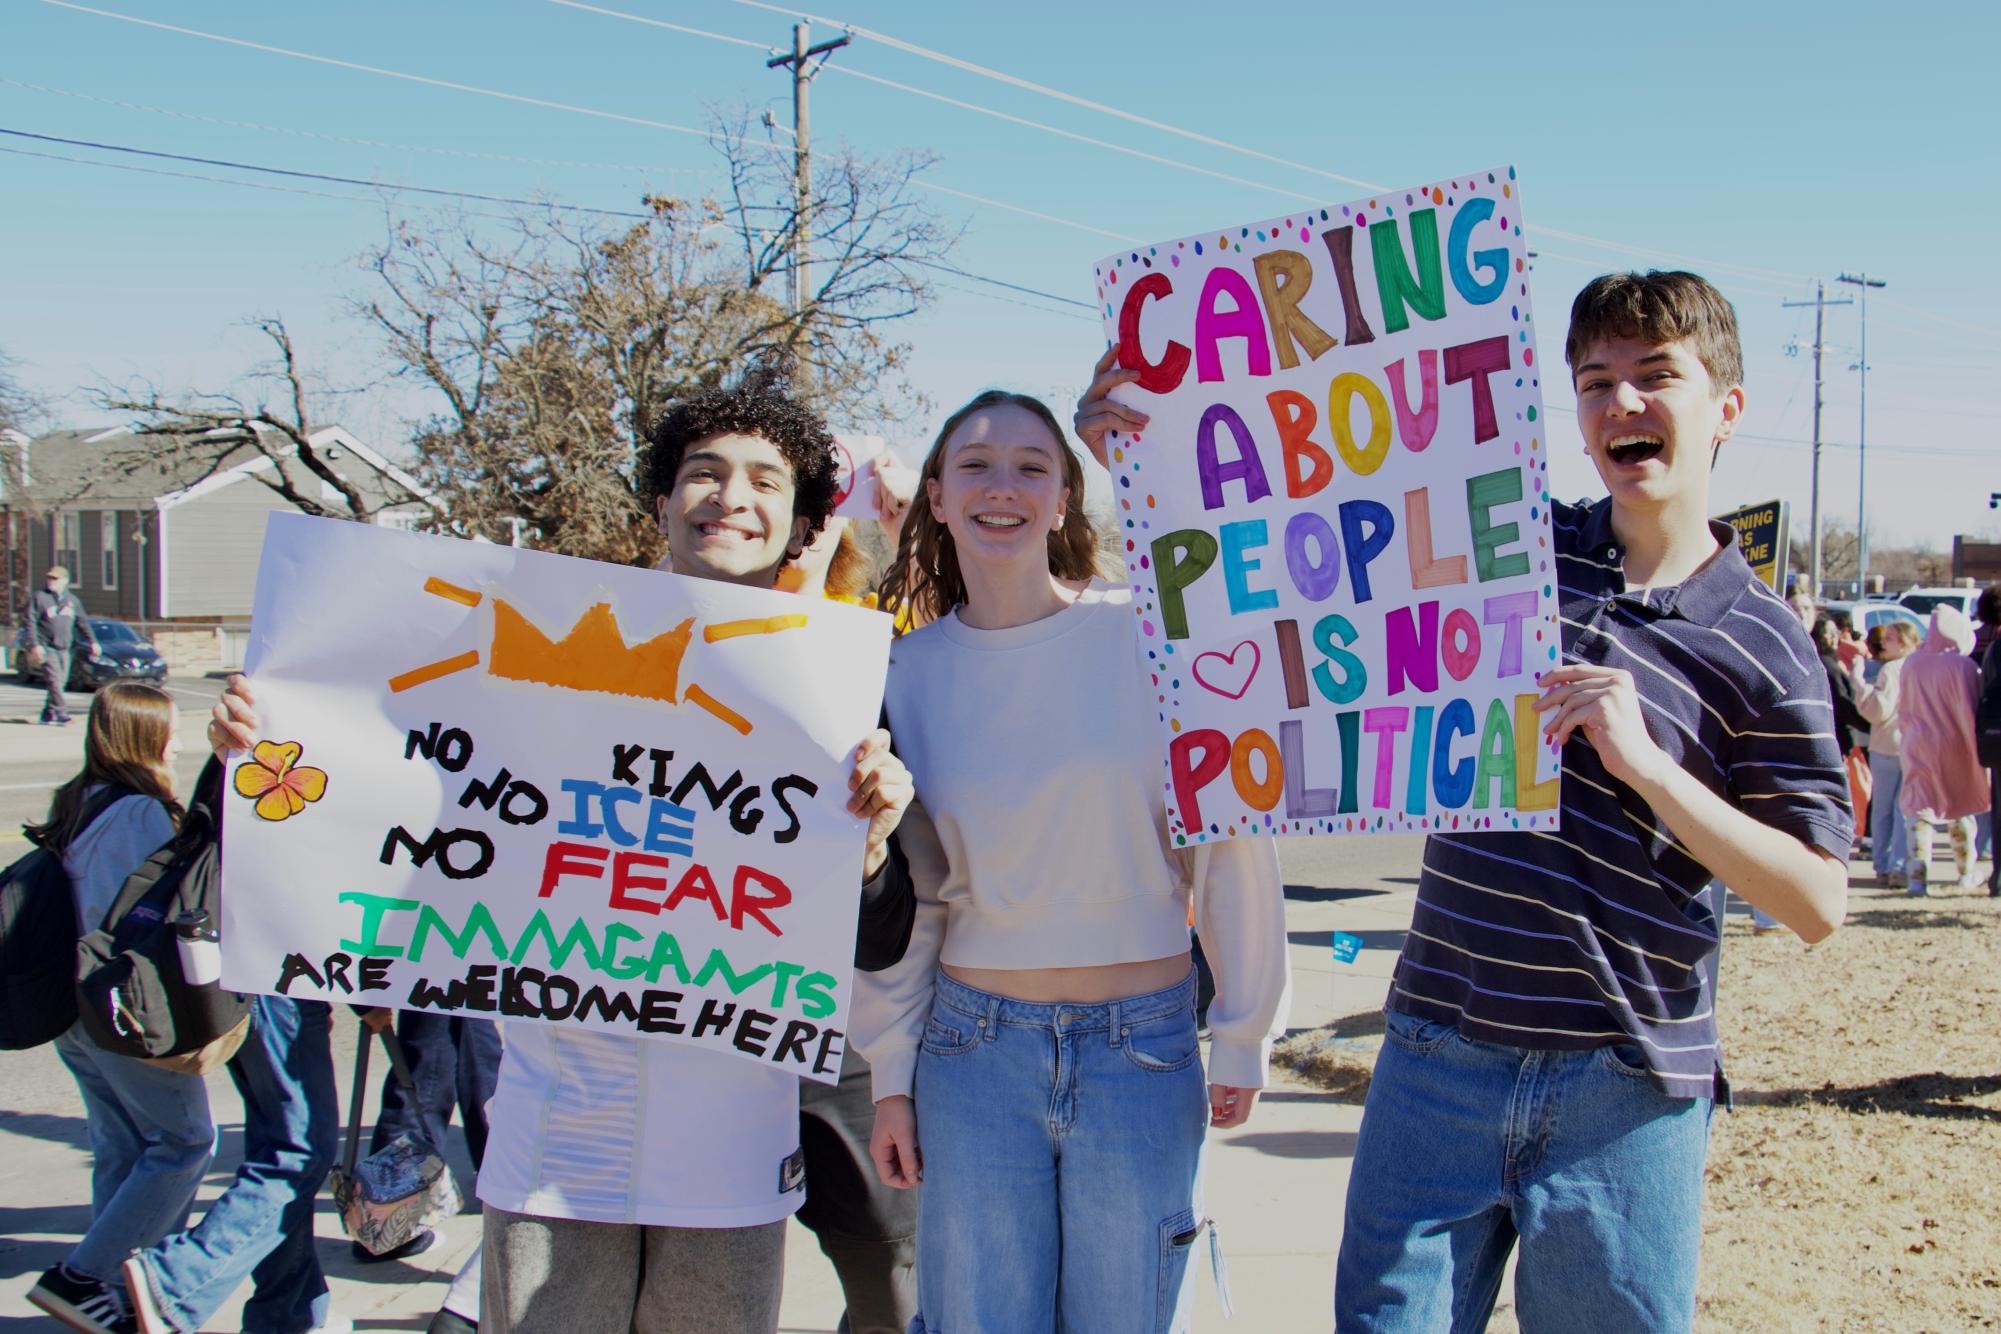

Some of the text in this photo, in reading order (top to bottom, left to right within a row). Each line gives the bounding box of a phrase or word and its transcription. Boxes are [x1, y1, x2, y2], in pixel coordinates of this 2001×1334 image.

[1118, 197, 1509, 395] CARING
[1196, 335, 1511, 511] ABOUT
[1150, 466, 1531, 640] PEOPLE
[1274, 591, 1539, 709] IS NOT
[404, 722, 818, 844] NO KINGS
[458, 767, 696, 858] NO ICE
[1169, 693, 1560, 836] POLITICAL
[379, 826, 792, 937] NO FEAR
[274, 952, 844, 1074] ARE WELCOME HERE
